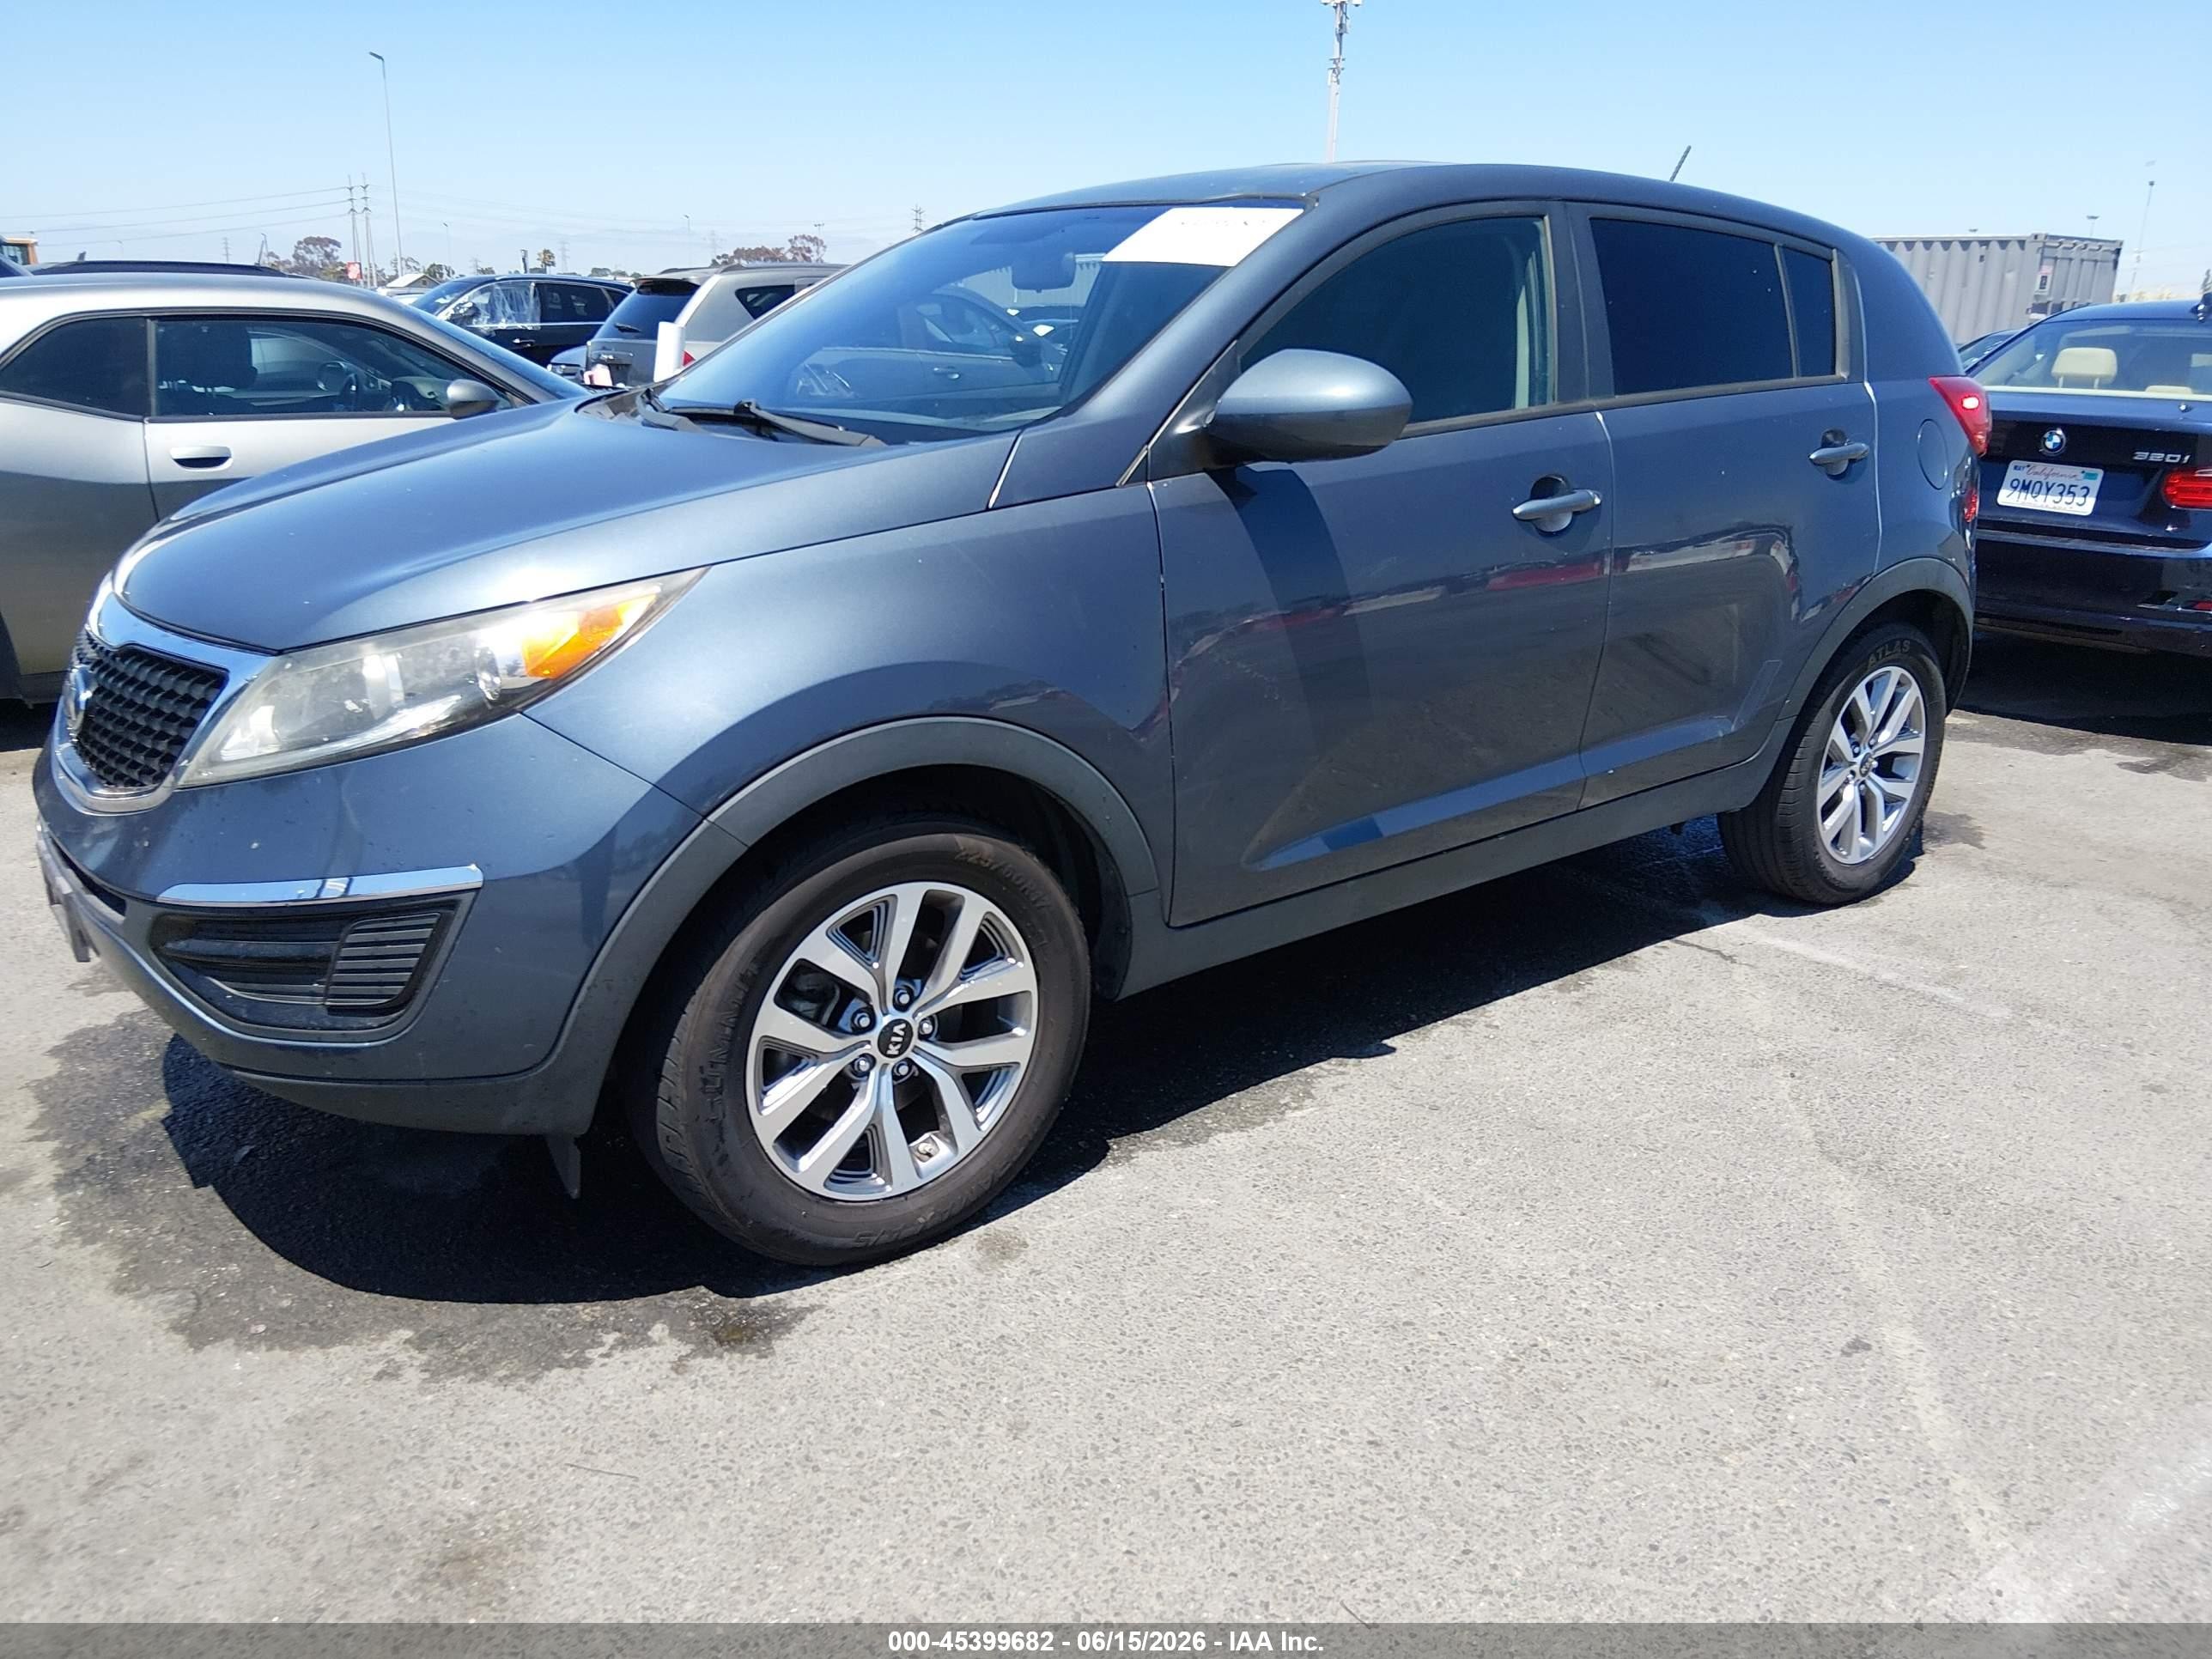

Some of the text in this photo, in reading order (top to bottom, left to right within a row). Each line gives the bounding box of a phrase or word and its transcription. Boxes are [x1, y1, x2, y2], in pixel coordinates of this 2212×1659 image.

[2027, 465, 2083, 481] California
[2006, 478, 2090, 507] 9MQY353
[1868, 639, 1911, 667] ATLAS
[886, 1023, 907, 1054] KIA
